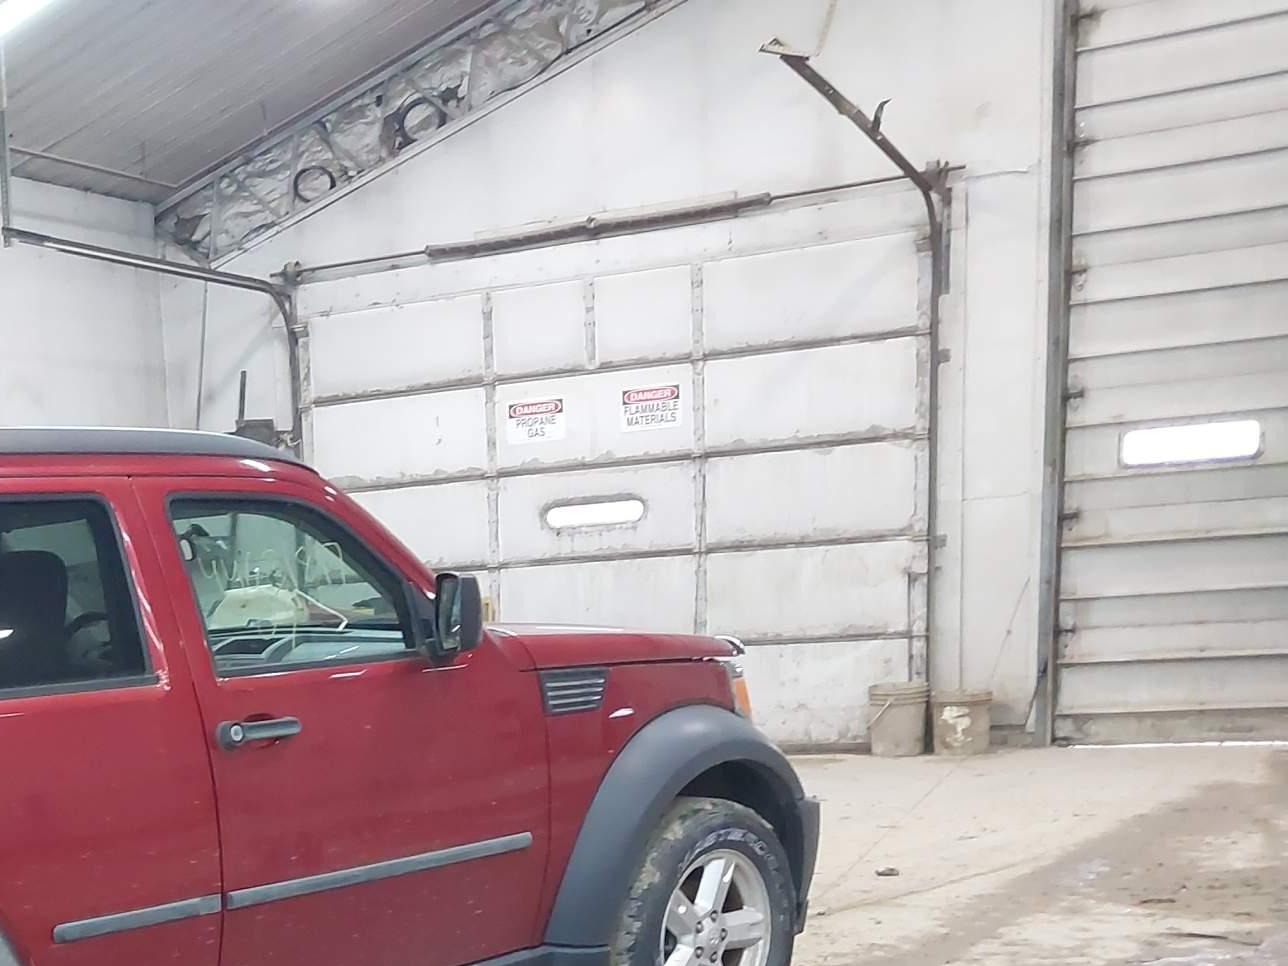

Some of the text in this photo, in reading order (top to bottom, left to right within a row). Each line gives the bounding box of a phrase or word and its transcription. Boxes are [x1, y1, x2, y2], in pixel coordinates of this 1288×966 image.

[629, 388, 672, 402] DANGER
[515, 403, 557, 416] DANGER
[624, 401, 679, 416] FLAMMABLE
[515, 415, 557, 429] PROPANE
[626, 412, 677, 426] MATERIALS
[527, 427, 546, 438] GAS
